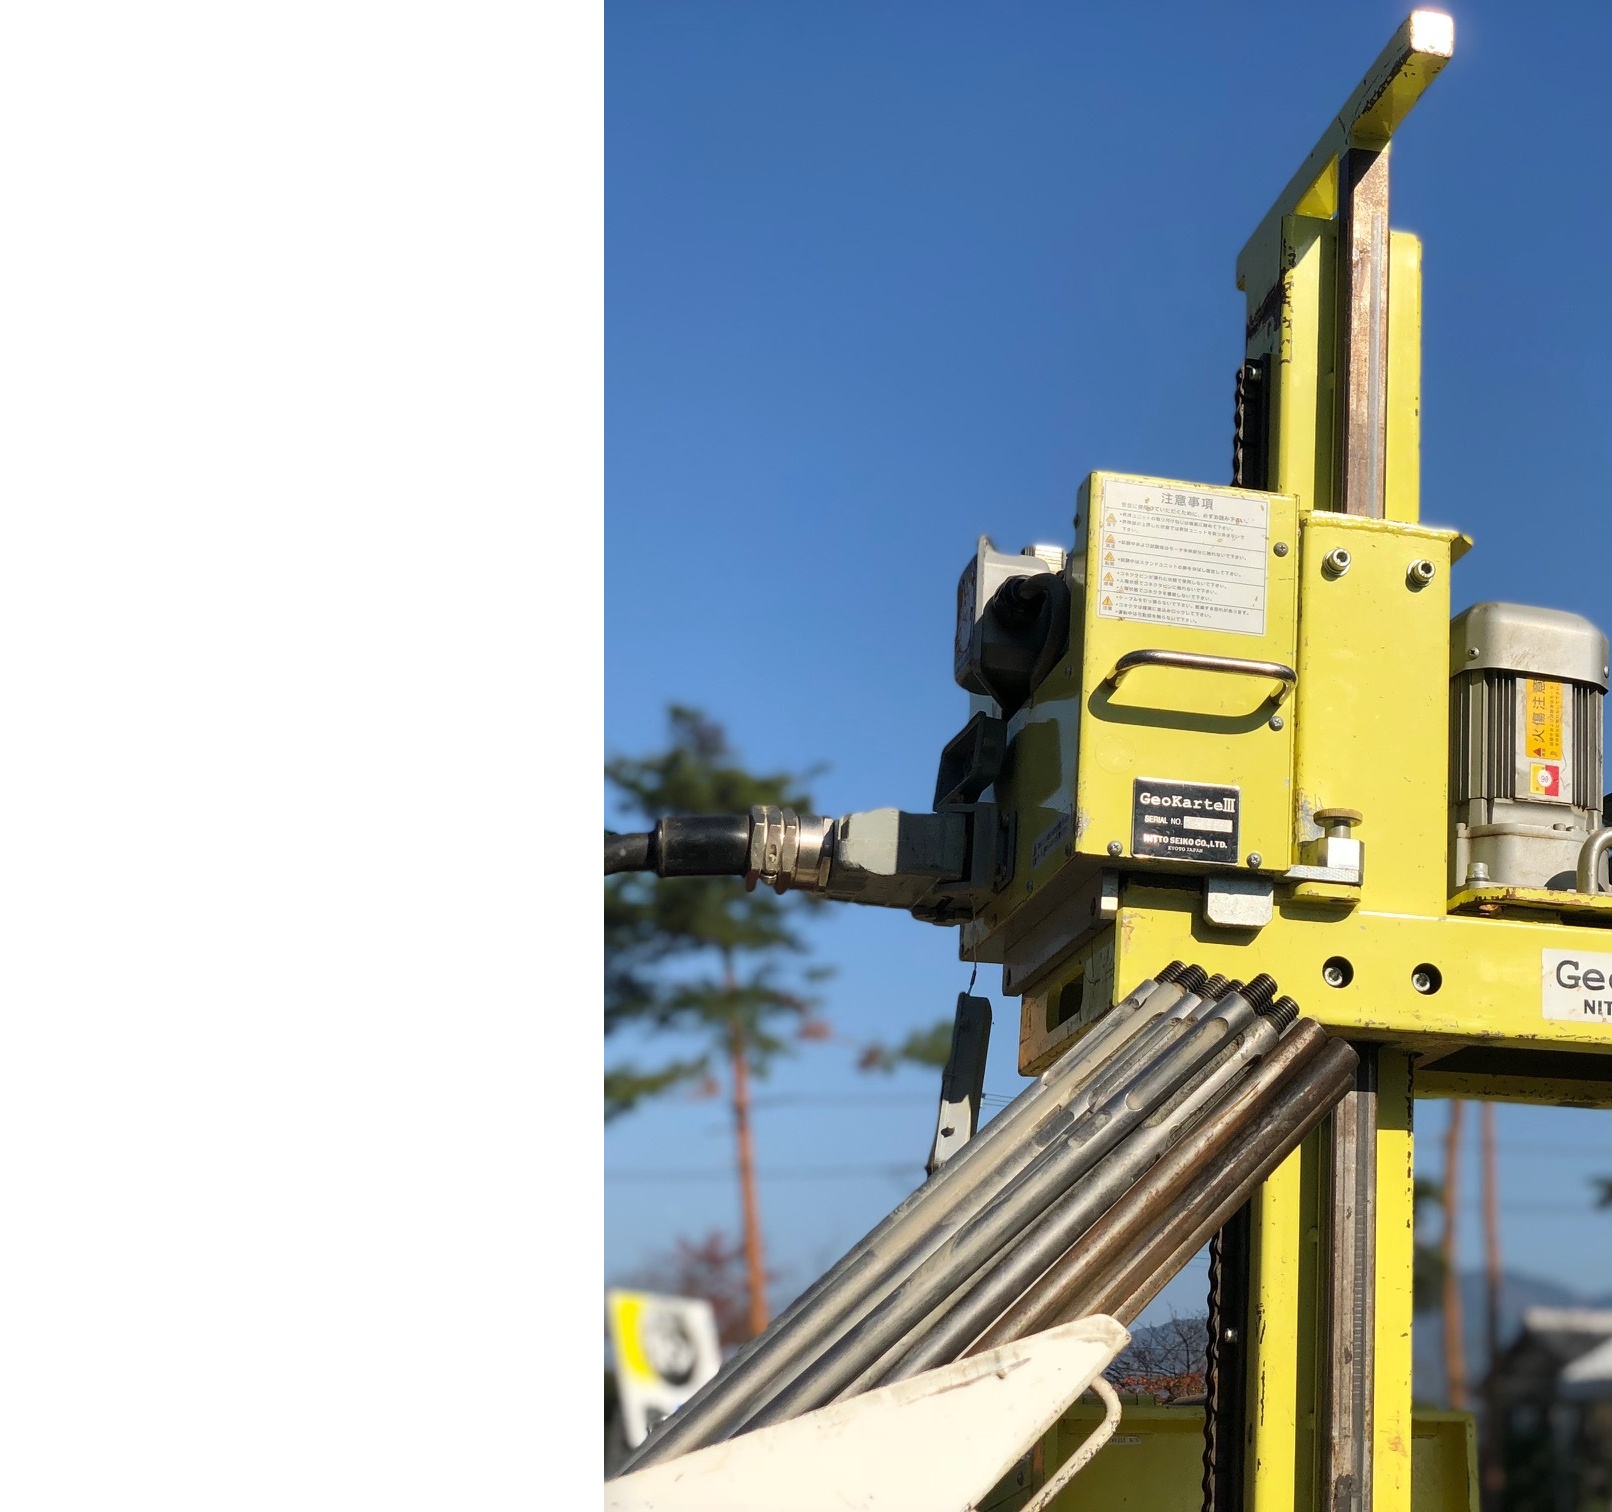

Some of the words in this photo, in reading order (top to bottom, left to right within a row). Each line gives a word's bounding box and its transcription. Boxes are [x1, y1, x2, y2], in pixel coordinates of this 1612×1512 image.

[1161, 492, 1214, 510] 注意事項
[1144, 814, 1169, 824] SERIAL
[1170, 817, 1183, 826] NO.
[1142, 833, 1169, 844] NITTO
[1169, 837, 1195, 846] SEIKO
[1195, 840, 1228, 849] CO.,LTD.
